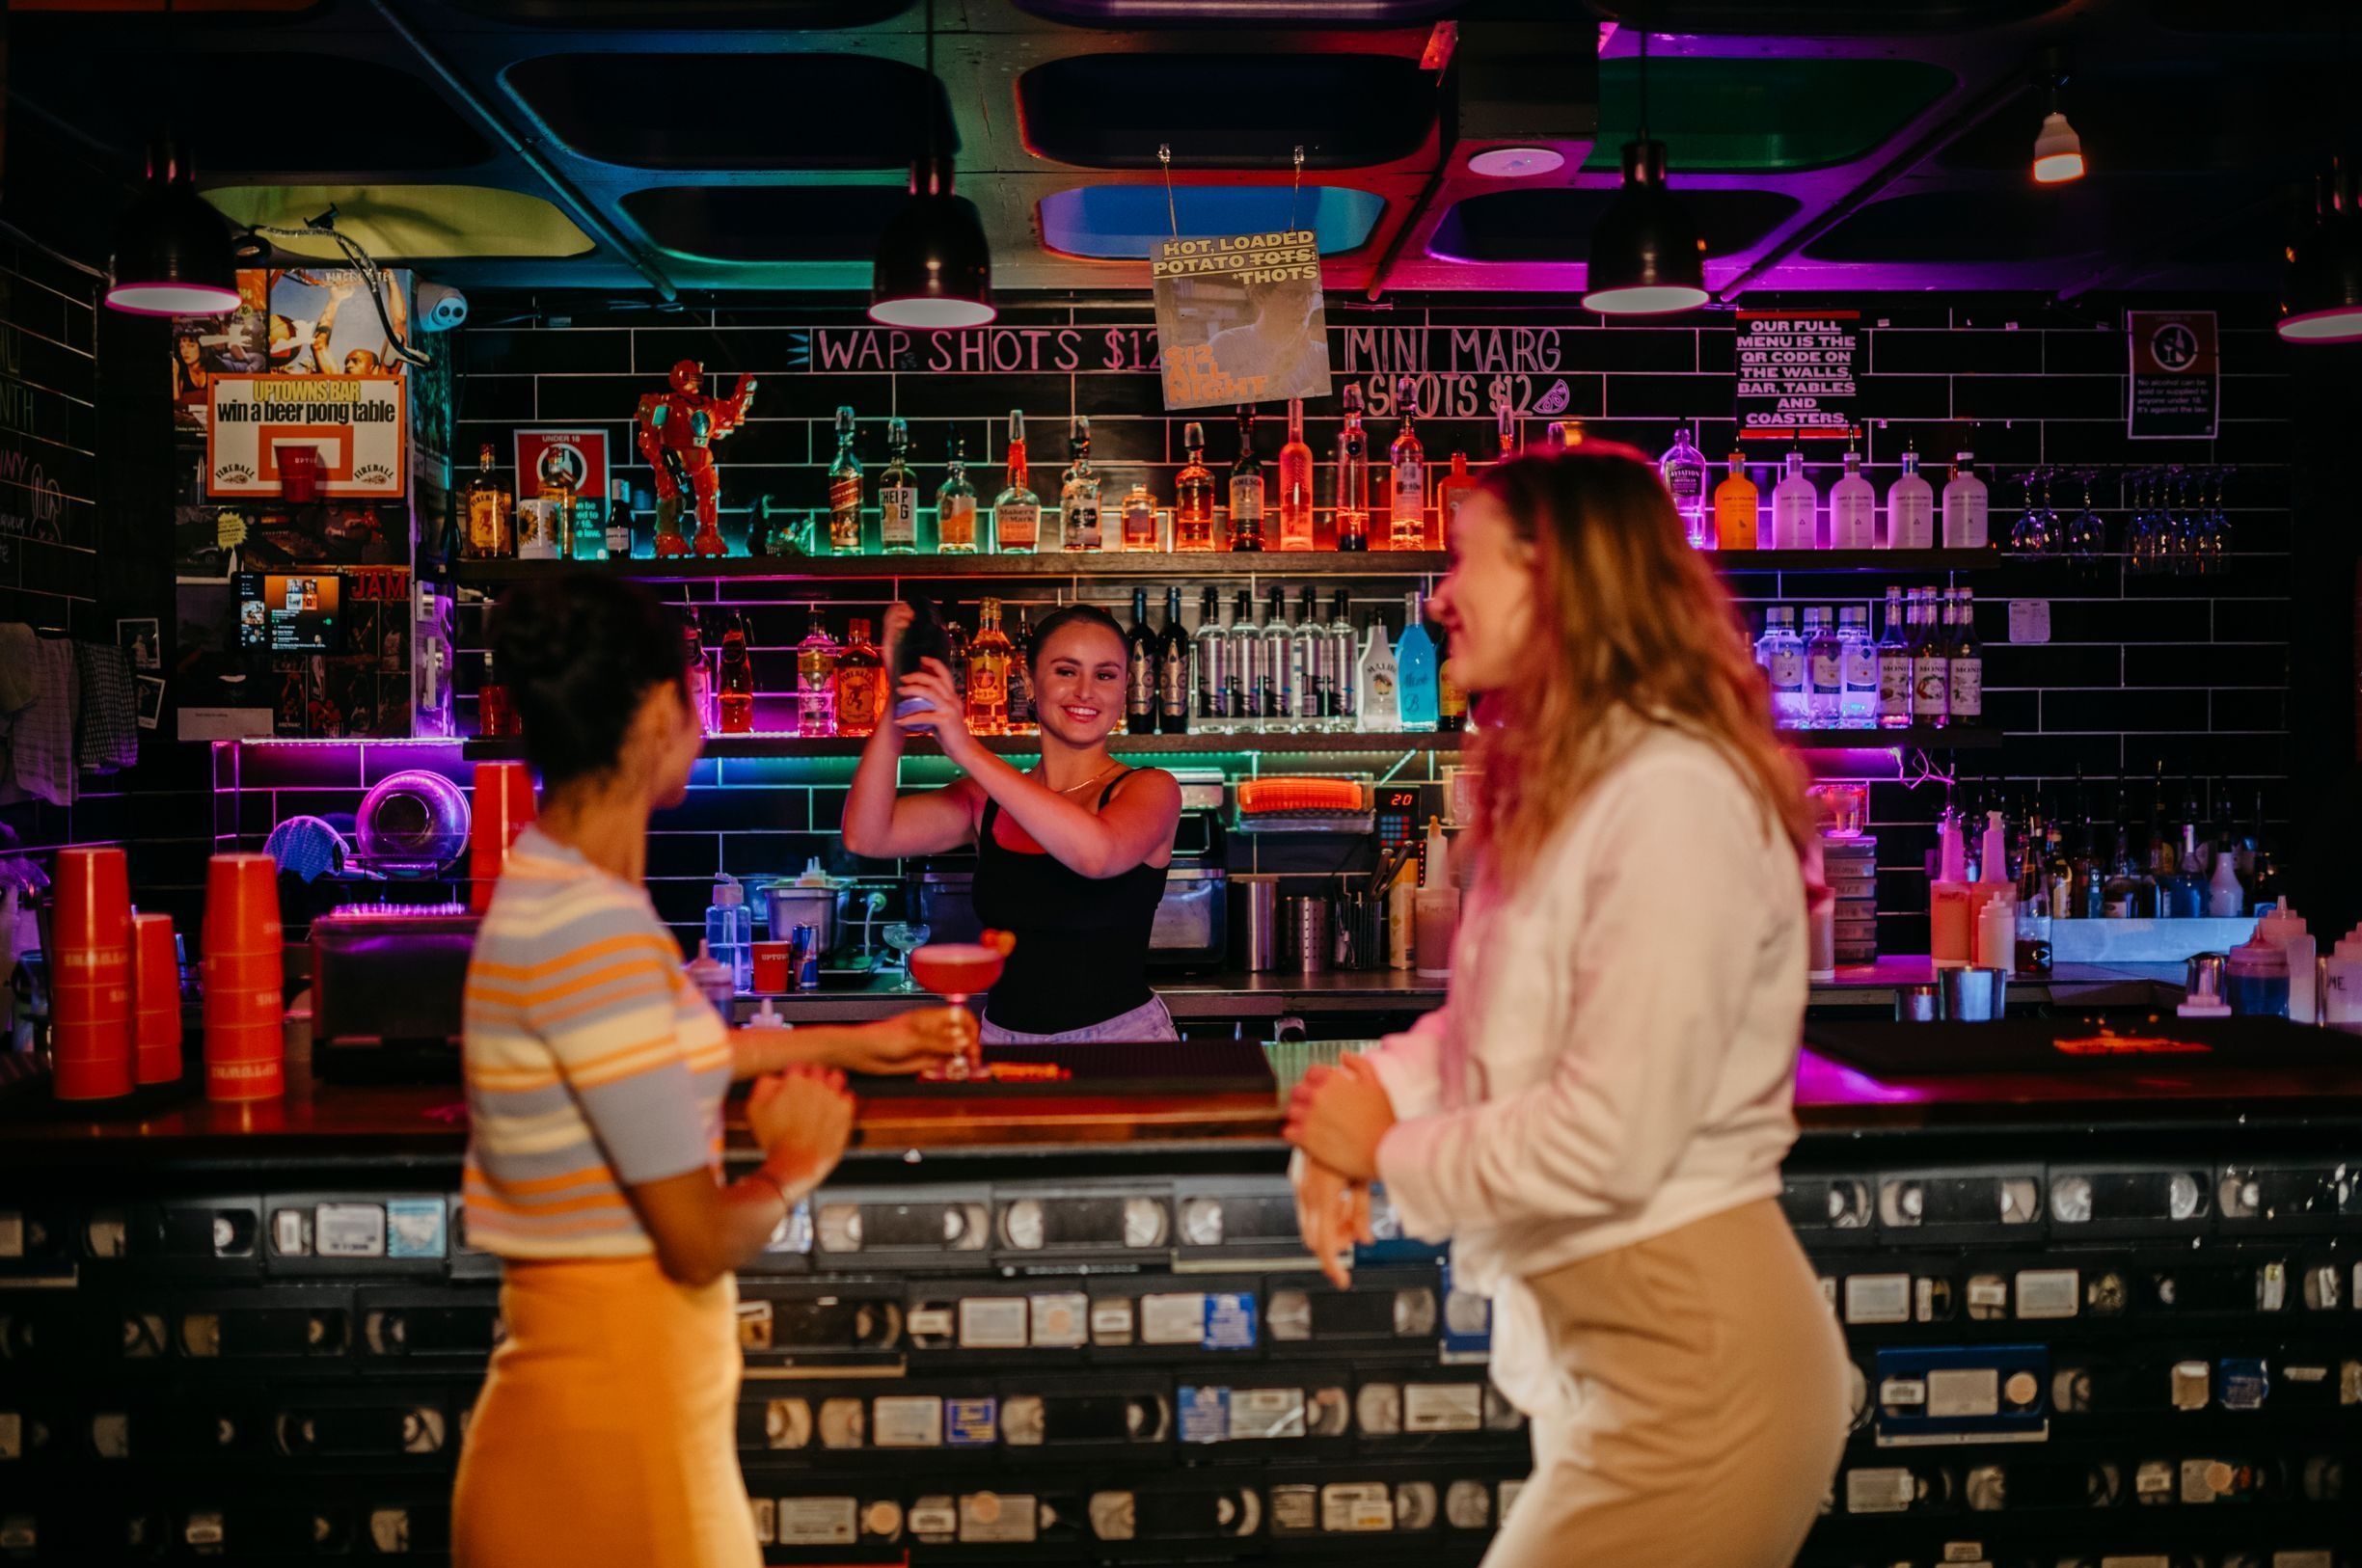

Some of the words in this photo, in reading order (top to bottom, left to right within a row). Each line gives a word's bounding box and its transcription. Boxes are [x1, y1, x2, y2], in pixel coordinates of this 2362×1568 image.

[1163, 240, 1214, 257] HOT,
[1219, 230, 1315, 251] LOADED
[1153, 255, 1244, 275] POTATO
[1751, 320, 1790, 332] OUR
[1794, 320, 1842, 332] FULL
[1736, 336, 1792, 347] MENU
[1797, 336, 1814, 347] IS
[1819, 336, 1856, 347] THE
[818, 329, 911, 369] WAP
[928, 329, 1082, 371] SHOTS
[1350, 329, 1429, 372] MINI
[1451, 329, 1561, 372] MARG
[1741, 351, 1767, 363] QR
[1771, 351, 1821, 363] CODE
[1825, 351, 1851, 363] ON
[1740, 366, 1778, 378] THE
[253, 380, 328, 402] UPTOWNS
[329, 380, 361, 402] BAR
[1784, 382, 1857, 393] TABLES
[1777, 397, 1817, 409] AND
[218, 399, 248, 421] win
[251, 403, 261, 421] a
[264, 401, 304, 421] beer
[307, 403, 349, 424] pong
[352, 400, 395, 421] table
[1746, 413, 1849, 424] COASTERS.
[215, 464, 255, 479] FIREBALL
[354, 464, 394, 479] FIREBALL
[351, 571, 407, 598] JAM
[1367, 662, 1398, 673] MALIB
[1391, 794, 1413, 806] 20
